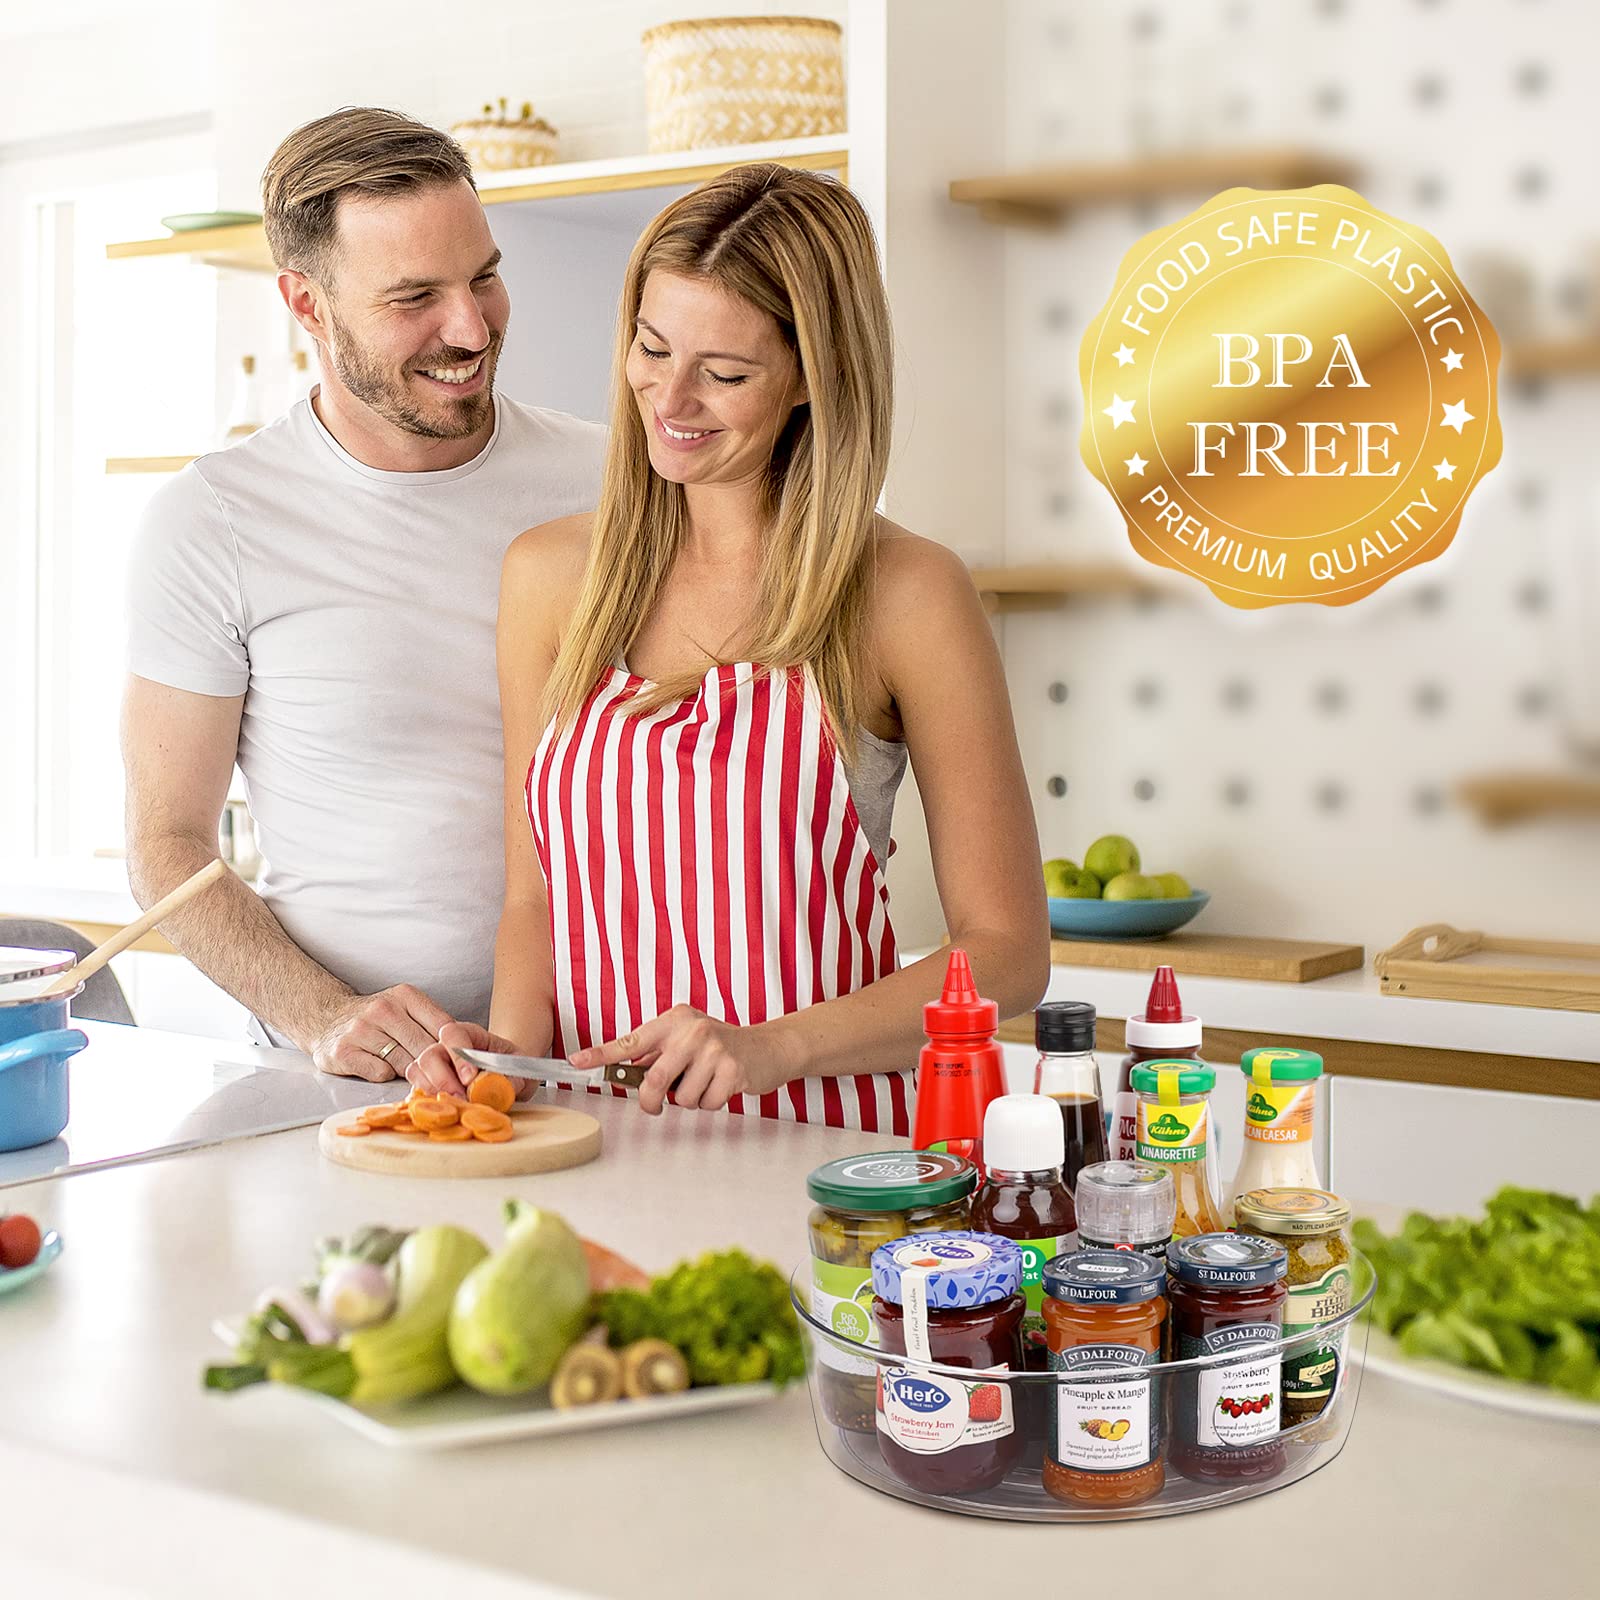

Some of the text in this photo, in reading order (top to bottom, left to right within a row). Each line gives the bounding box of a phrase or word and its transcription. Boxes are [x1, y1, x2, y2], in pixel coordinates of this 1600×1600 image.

[1150, 1124, 1187, 1136] Kühne
[1262, 1128, 1298, 1141] CAESAR
[1141, 1145, 1197, 1160] VINAIGRETTE
[933, 1247, 973, 1259] Hero
[1210, 1271, 1256, 1281] DALFOUR
[1070, 1289, 1117, 1299] DALFOUR
[836, 1321, 864, 1337] Santo
[1227, 1327, 1277, 1341] DALFOUR
[1081, 1349, 1139, 1364] DALFOUR
[1223, 1366, 1270, 1379] Strawberry
[900, 1383, 945, 1403] Hero
[1062, 1386, 1147, 1402] Pineapple & Mango
[890, 1413, 955, 1430] Strawberry Jam
